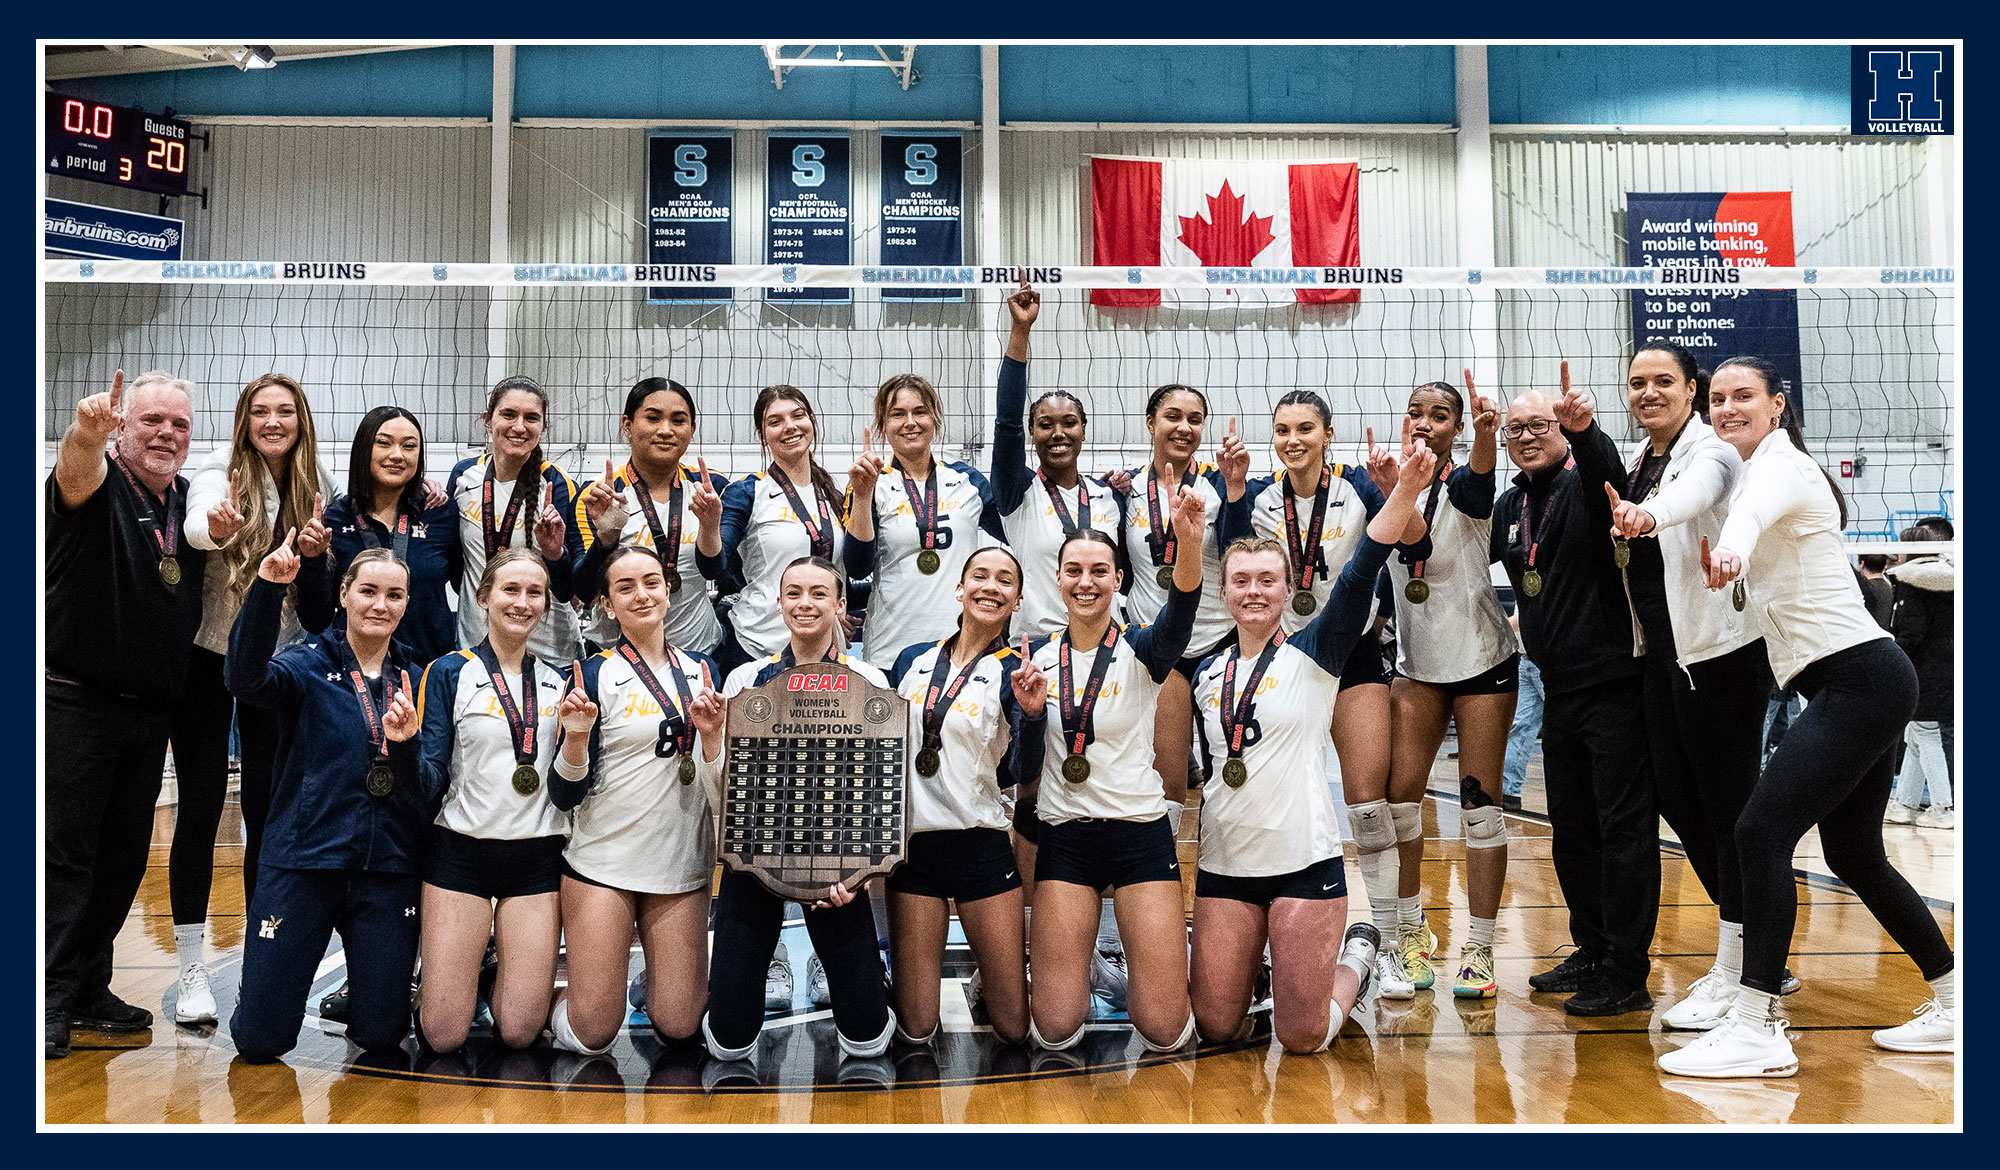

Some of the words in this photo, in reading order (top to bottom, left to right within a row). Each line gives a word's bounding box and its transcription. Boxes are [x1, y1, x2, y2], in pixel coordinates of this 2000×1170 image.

[65, 100, 113, 139] 0.0
[144, 118, 185, 139] Guests
[147, 137, 185, 173] 20
[66, 155, 106, 173] period
[119, 157, 133, 181] 3
[674, 144, 708, 187] S
[792, 144, 825, 187] S
[905, 144, 938, 186] S
[882, 205, 960, 217] CHAMPIONS
[919, 198, 948, 206] HOCKEY
[651, 207, 730, 218] CHAMPIONS
[769, 207, 848, 218] CHAMPIONS
[1641, 218, 1692, 233] Award
[1695, 219, 1758, 237] winning
[1642, 236, 1697, 251] mobile
[1700, 236, 1769, 255] banking,
[1643, 254, 1653, 267] 3
[1657, 257, 1700, 267] years
[1704, 254, 1719, 267] in
[1723, 257, 1733, 267] a
[161, 262, 275, 279] SHERIDAN
[283, 263, 366, 280] BRUINS
[514, 264, 627, 282] SHERIDAN
[635, 265, 717, 282] BRUINS
[862, 266, 974, 283] SHERIDAN
[981, 267, 1063, 284] BRUINS
[1205, 267, 1317, 284] SHERIDAN
[1324, 268, 1403, 284] BRUINS
[1545, 268, 1655, 284] SHERIDAN
[1661, 268, 1740, 284] BRUINS
[1712, 288, 1749, 299] pays
[1645, 300, 1663, 313] to
[1667, 298, 1687, 313] be
[1690, 301, 1711, 313] on
[1646, 319, 1673, 330] our
[1677, 315, 1735, 334] phones
[787, 673, 848, 692] OCAA
[795, 698, 840, 708] WOMEN'S
[790, 709, 847, 719] VOLLEYBALL
[772, 723, 863, 735] CHAMPIONS
